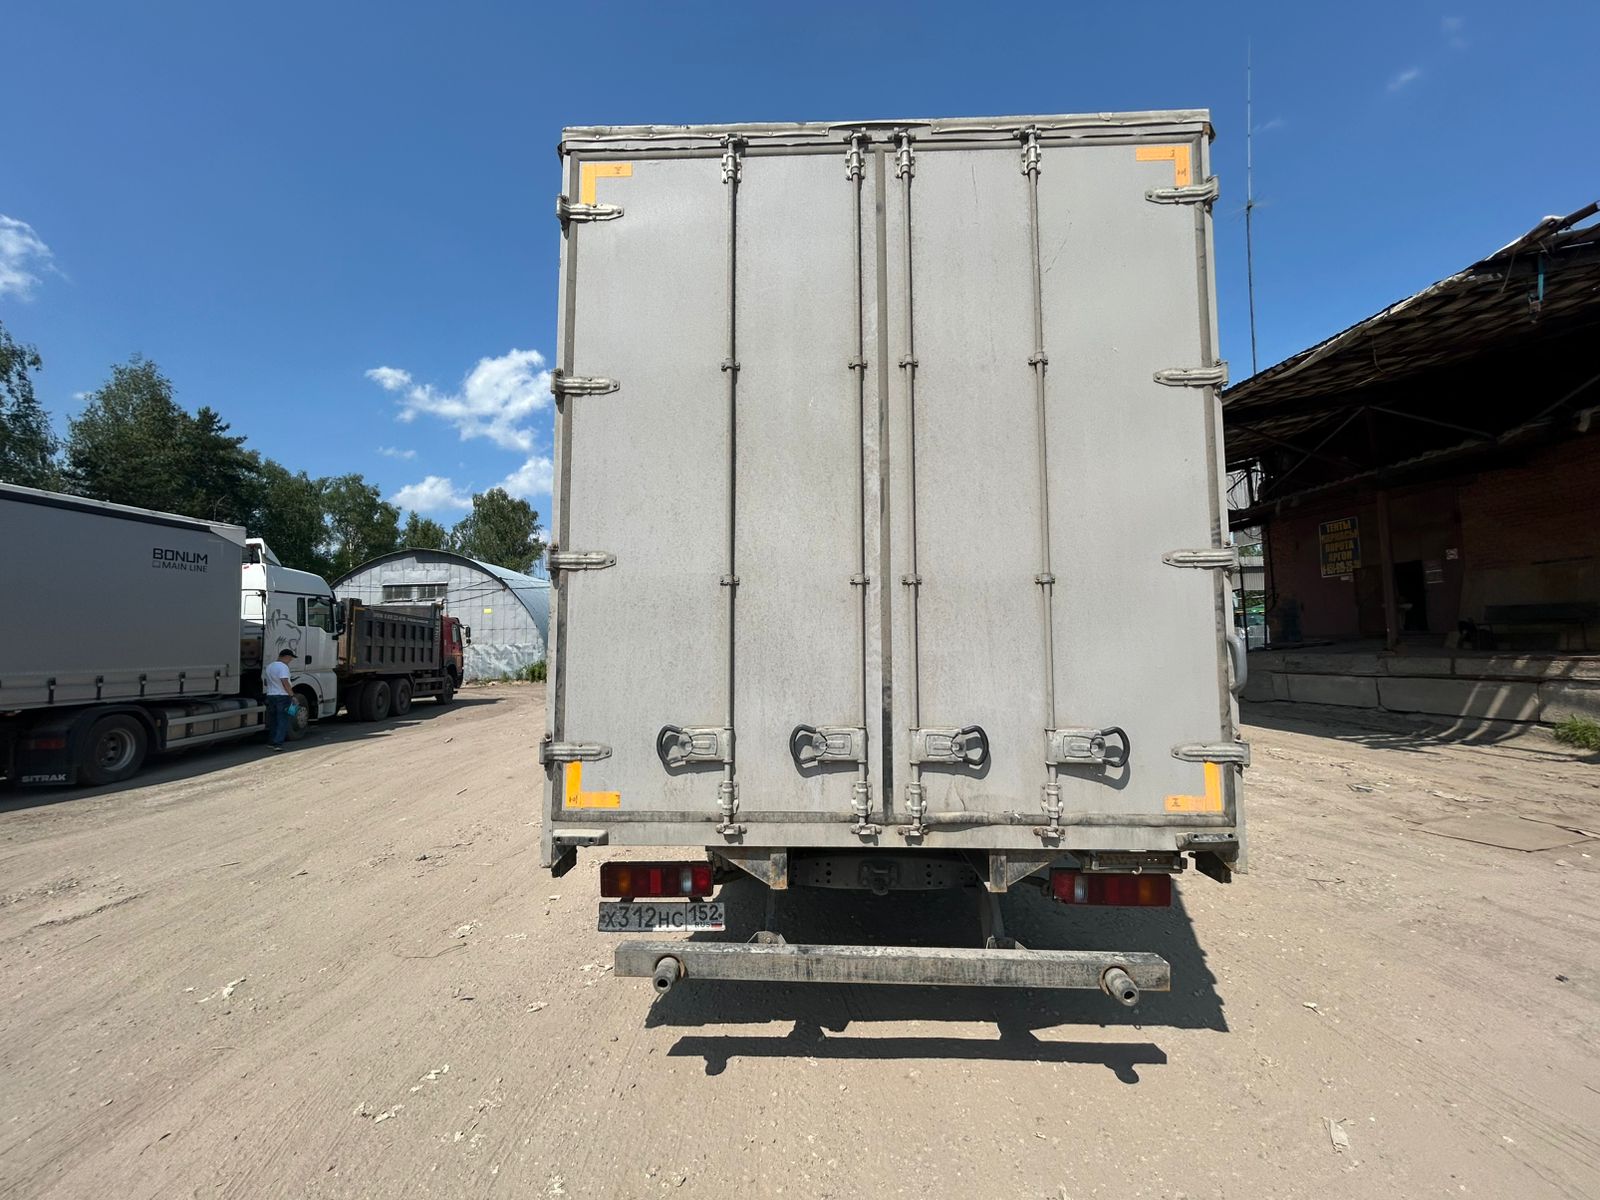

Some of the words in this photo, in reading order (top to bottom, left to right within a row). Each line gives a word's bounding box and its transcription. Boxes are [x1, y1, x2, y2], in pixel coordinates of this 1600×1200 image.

[153, 548, 208, 565] BONUM
[162, 561, 187, 571] MAIN
[190, 564, 208, 573] LINE
[22, 774, 66, 783] SITRAK
